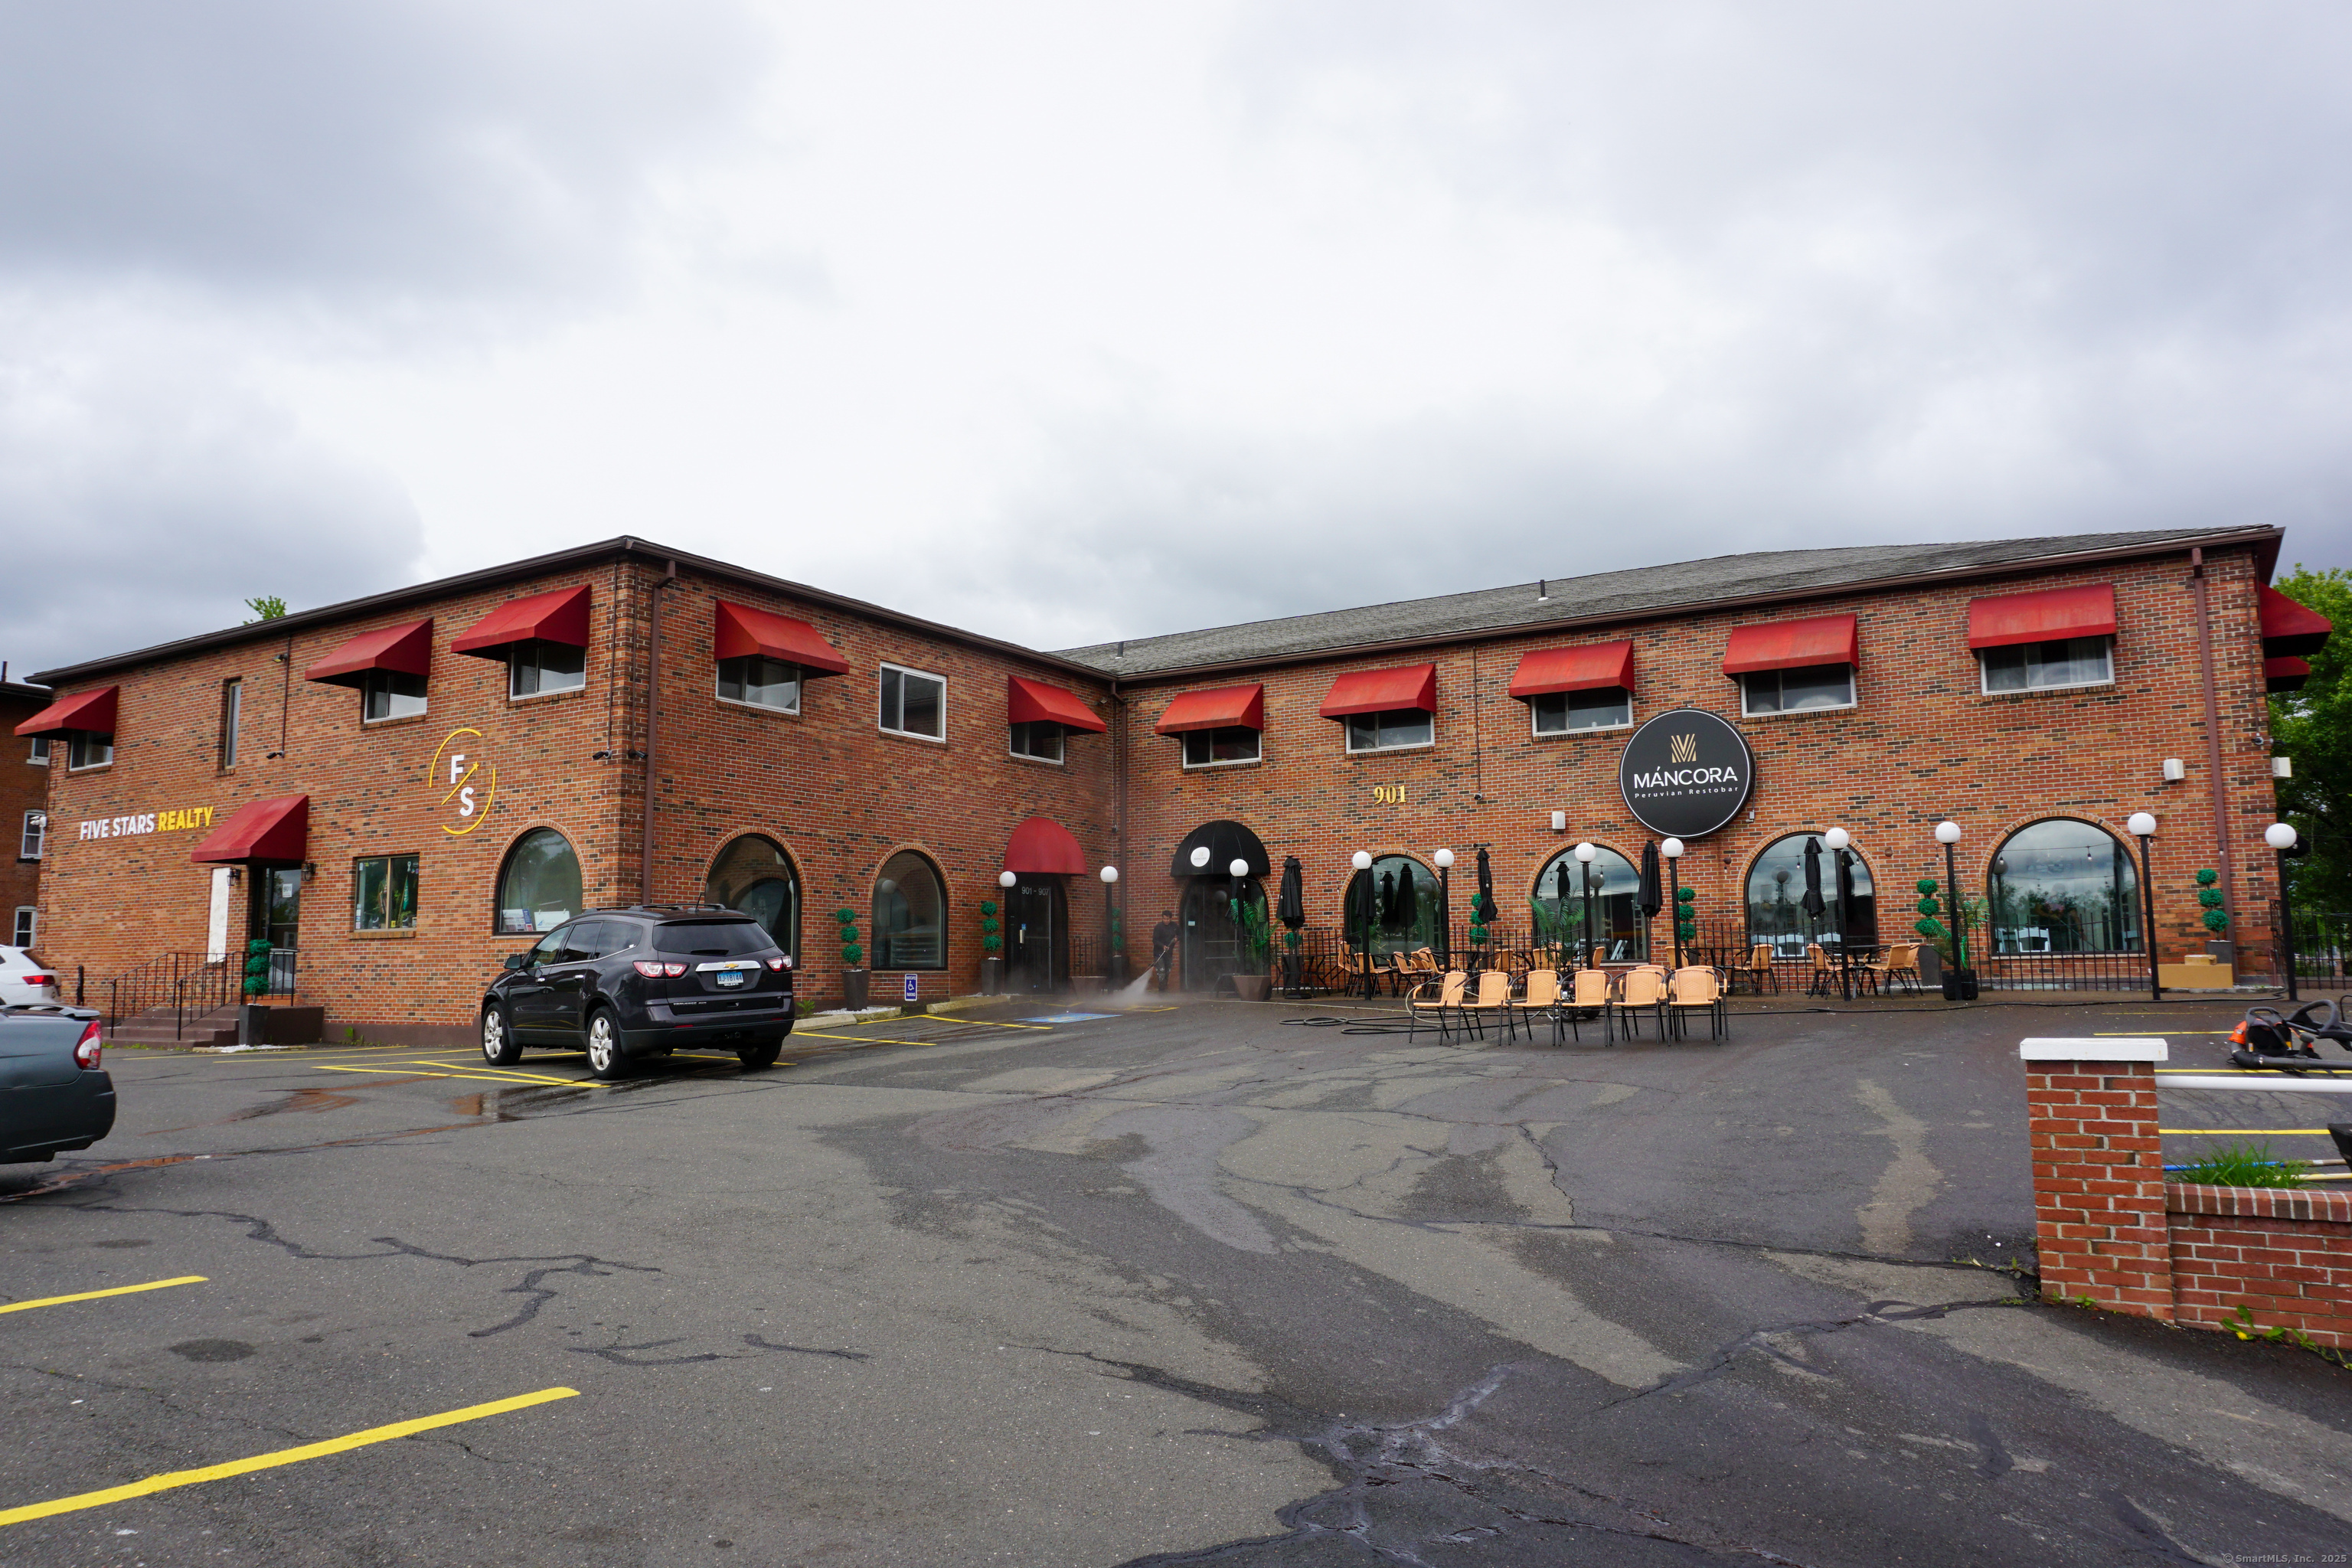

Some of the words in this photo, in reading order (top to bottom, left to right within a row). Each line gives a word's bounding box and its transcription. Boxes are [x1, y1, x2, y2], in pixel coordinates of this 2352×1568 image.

[450, 754, 465, 784] F
[1633, 766, 1738, 789] MÁNCORA
[459, 786, 475, 817] S
[1374, 785, 1407, 805] 901
[1635, 790, 1682, 799] Peruvian
[1688, 786, 1739, 795] Restobar
[80, 818, 109, 841] FIVE
[112, 813, 155, 837] STARS
[158, 806, 214, 832] REALTY
[1021, 887, 1032, 895] 901
